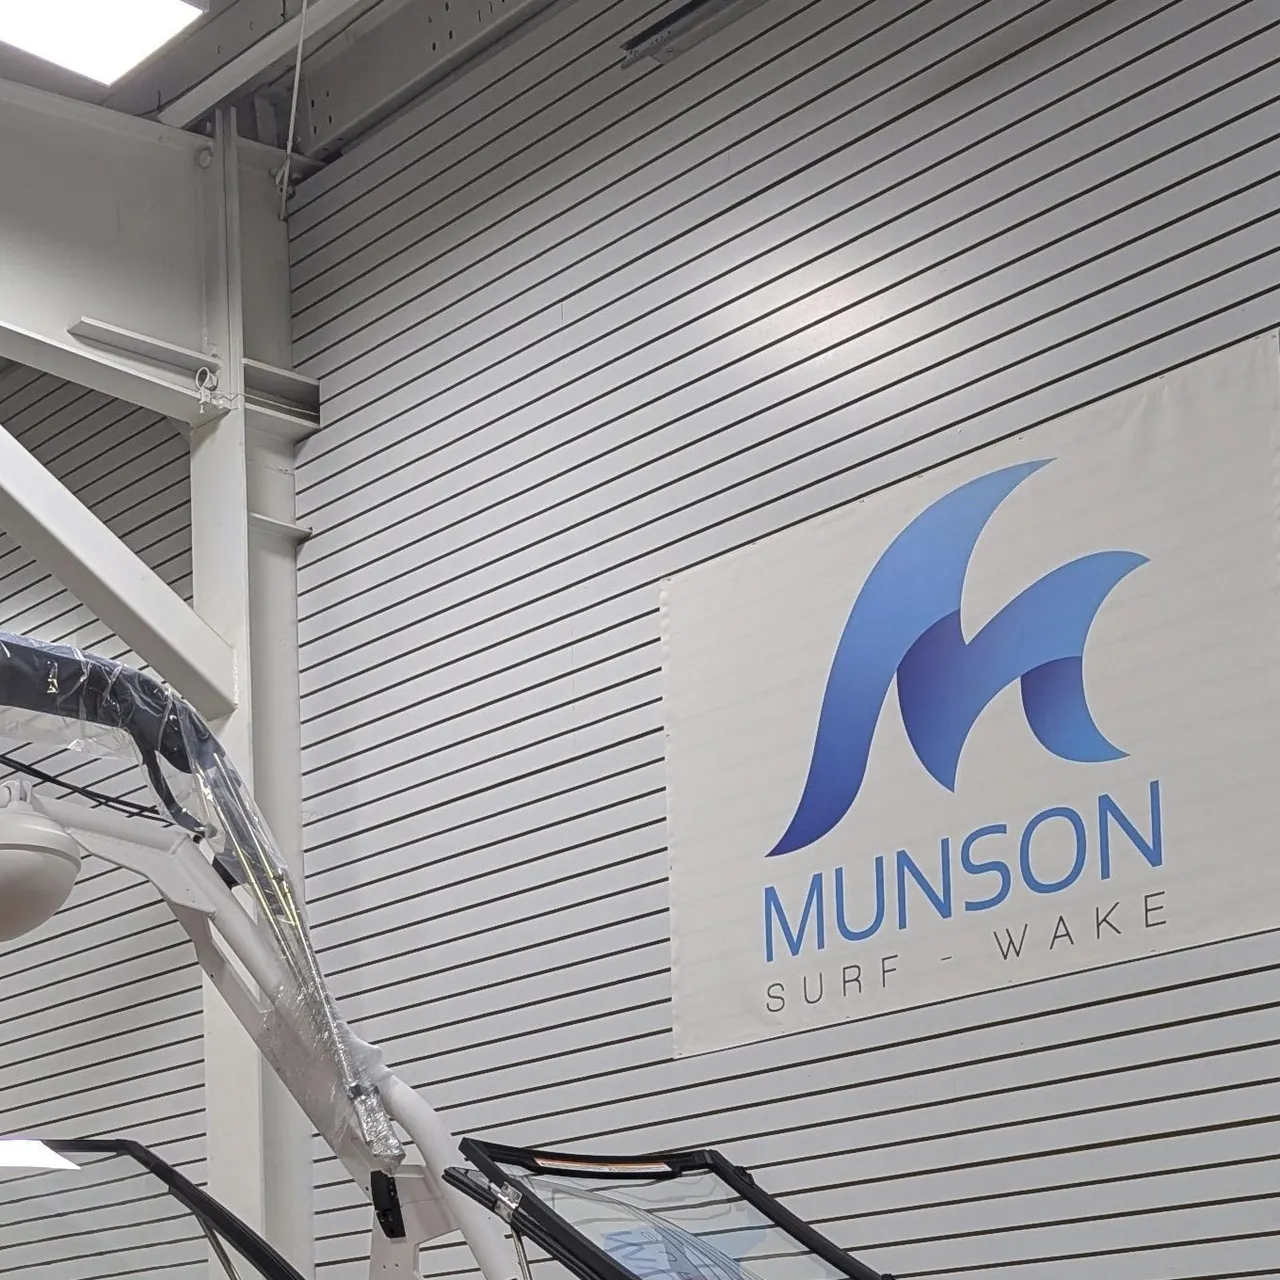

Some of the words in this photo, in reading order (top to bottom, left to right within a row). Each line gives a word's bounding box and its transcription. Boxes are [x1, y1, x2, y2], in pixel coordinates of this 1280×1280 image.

[763, 779, 1164, 963] MUNSON
[765, 954, 899, 1013] SURF
[992, 890, 1167, 962] WAKE
